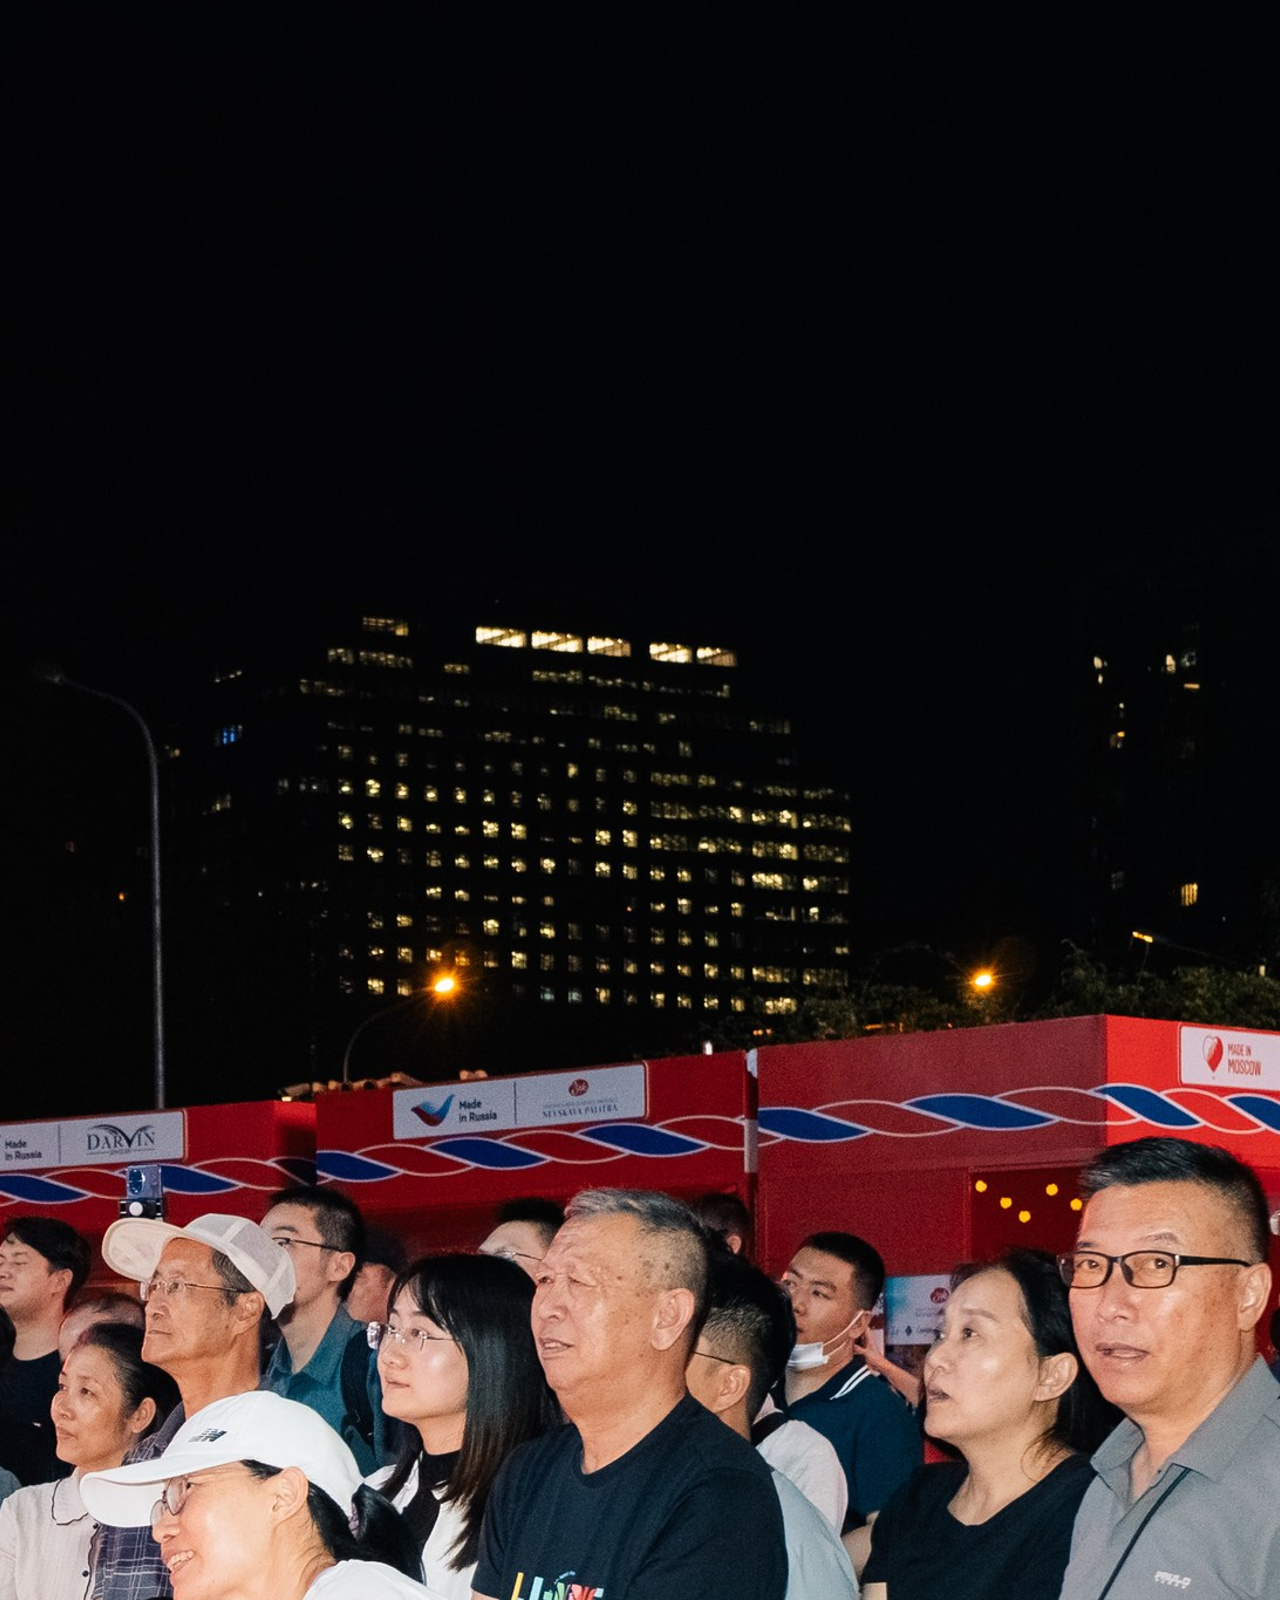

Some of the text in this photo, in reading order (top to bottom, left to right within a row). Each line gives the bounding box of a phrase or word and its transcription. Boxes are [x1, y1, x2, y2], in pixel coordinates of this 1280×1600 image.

[1227, 1043, 1252, 1056] MADE IN
[1227, 1058, 1262, 1076] MOSCOW
[459, 1098, 482, 1110] Made
[459, 1109, 497, 1123] in Russia
[87, 1124, 156, 1150] DARVIN
[5, 1140, 27, 1149] Made
[4, 1150, 42, 1161] in Russia
